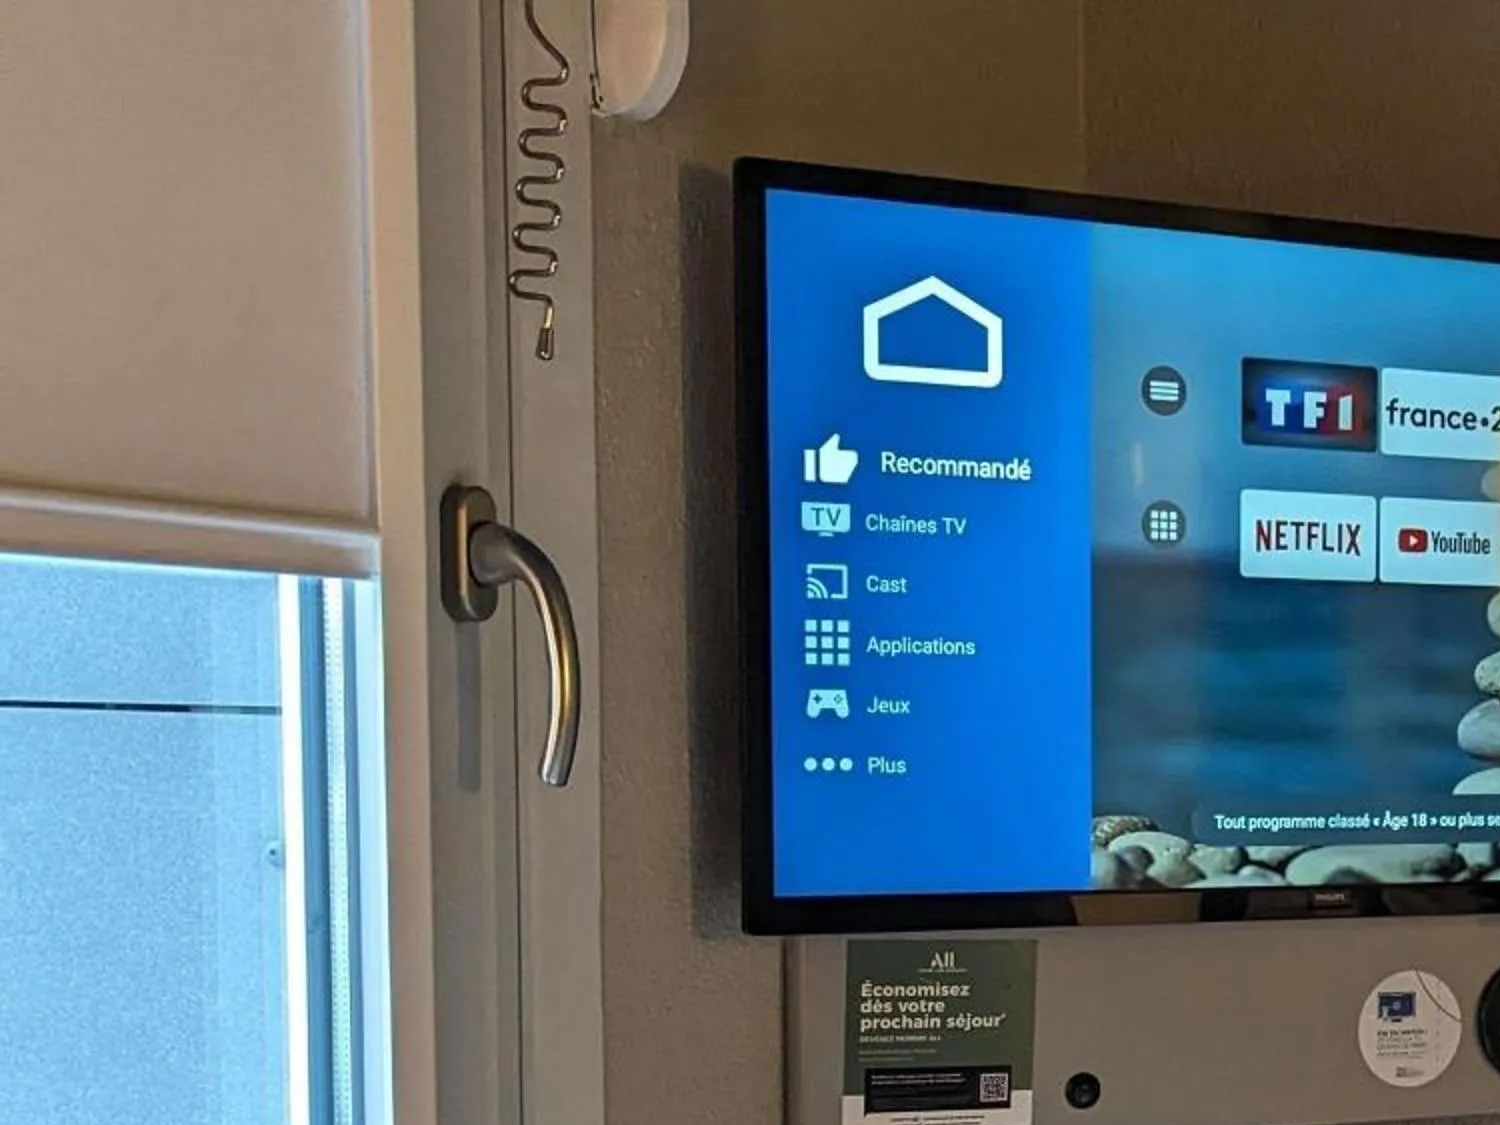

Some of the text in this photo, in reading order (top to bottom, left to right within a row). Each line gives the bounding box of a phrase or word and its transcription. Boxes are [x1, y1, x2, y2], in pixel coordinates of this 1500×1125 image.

[1265, 387, 1354, 431] TF1
[881, 451, 1033, 481] Recommandé
[811, 508, 842, 527] TV
[942, 517, 967, 536] TV
[1255, 519, 1361, 557] NETFLIX
[1431, 531, 1491, 555] YouTube
[866, 575, 907, 593] Cast
[866, 636, 976, 657] Applications
[867, 696, 911, 714] Jeux
[868, 757, 907, 775] Plus
[1214, 814, 1246, 830] Tout
[1248, 816, 1326, 833] programme
[1327, 812, 1370, 829] classé
[1439, 815, 1457, 827] ou
[1458, 811, 1484, 830] plus
[860, 979, 971, 998] Économisez
[898, 1000, 945, 1014] votre
[860, 1013, 941, 1032] prochain
